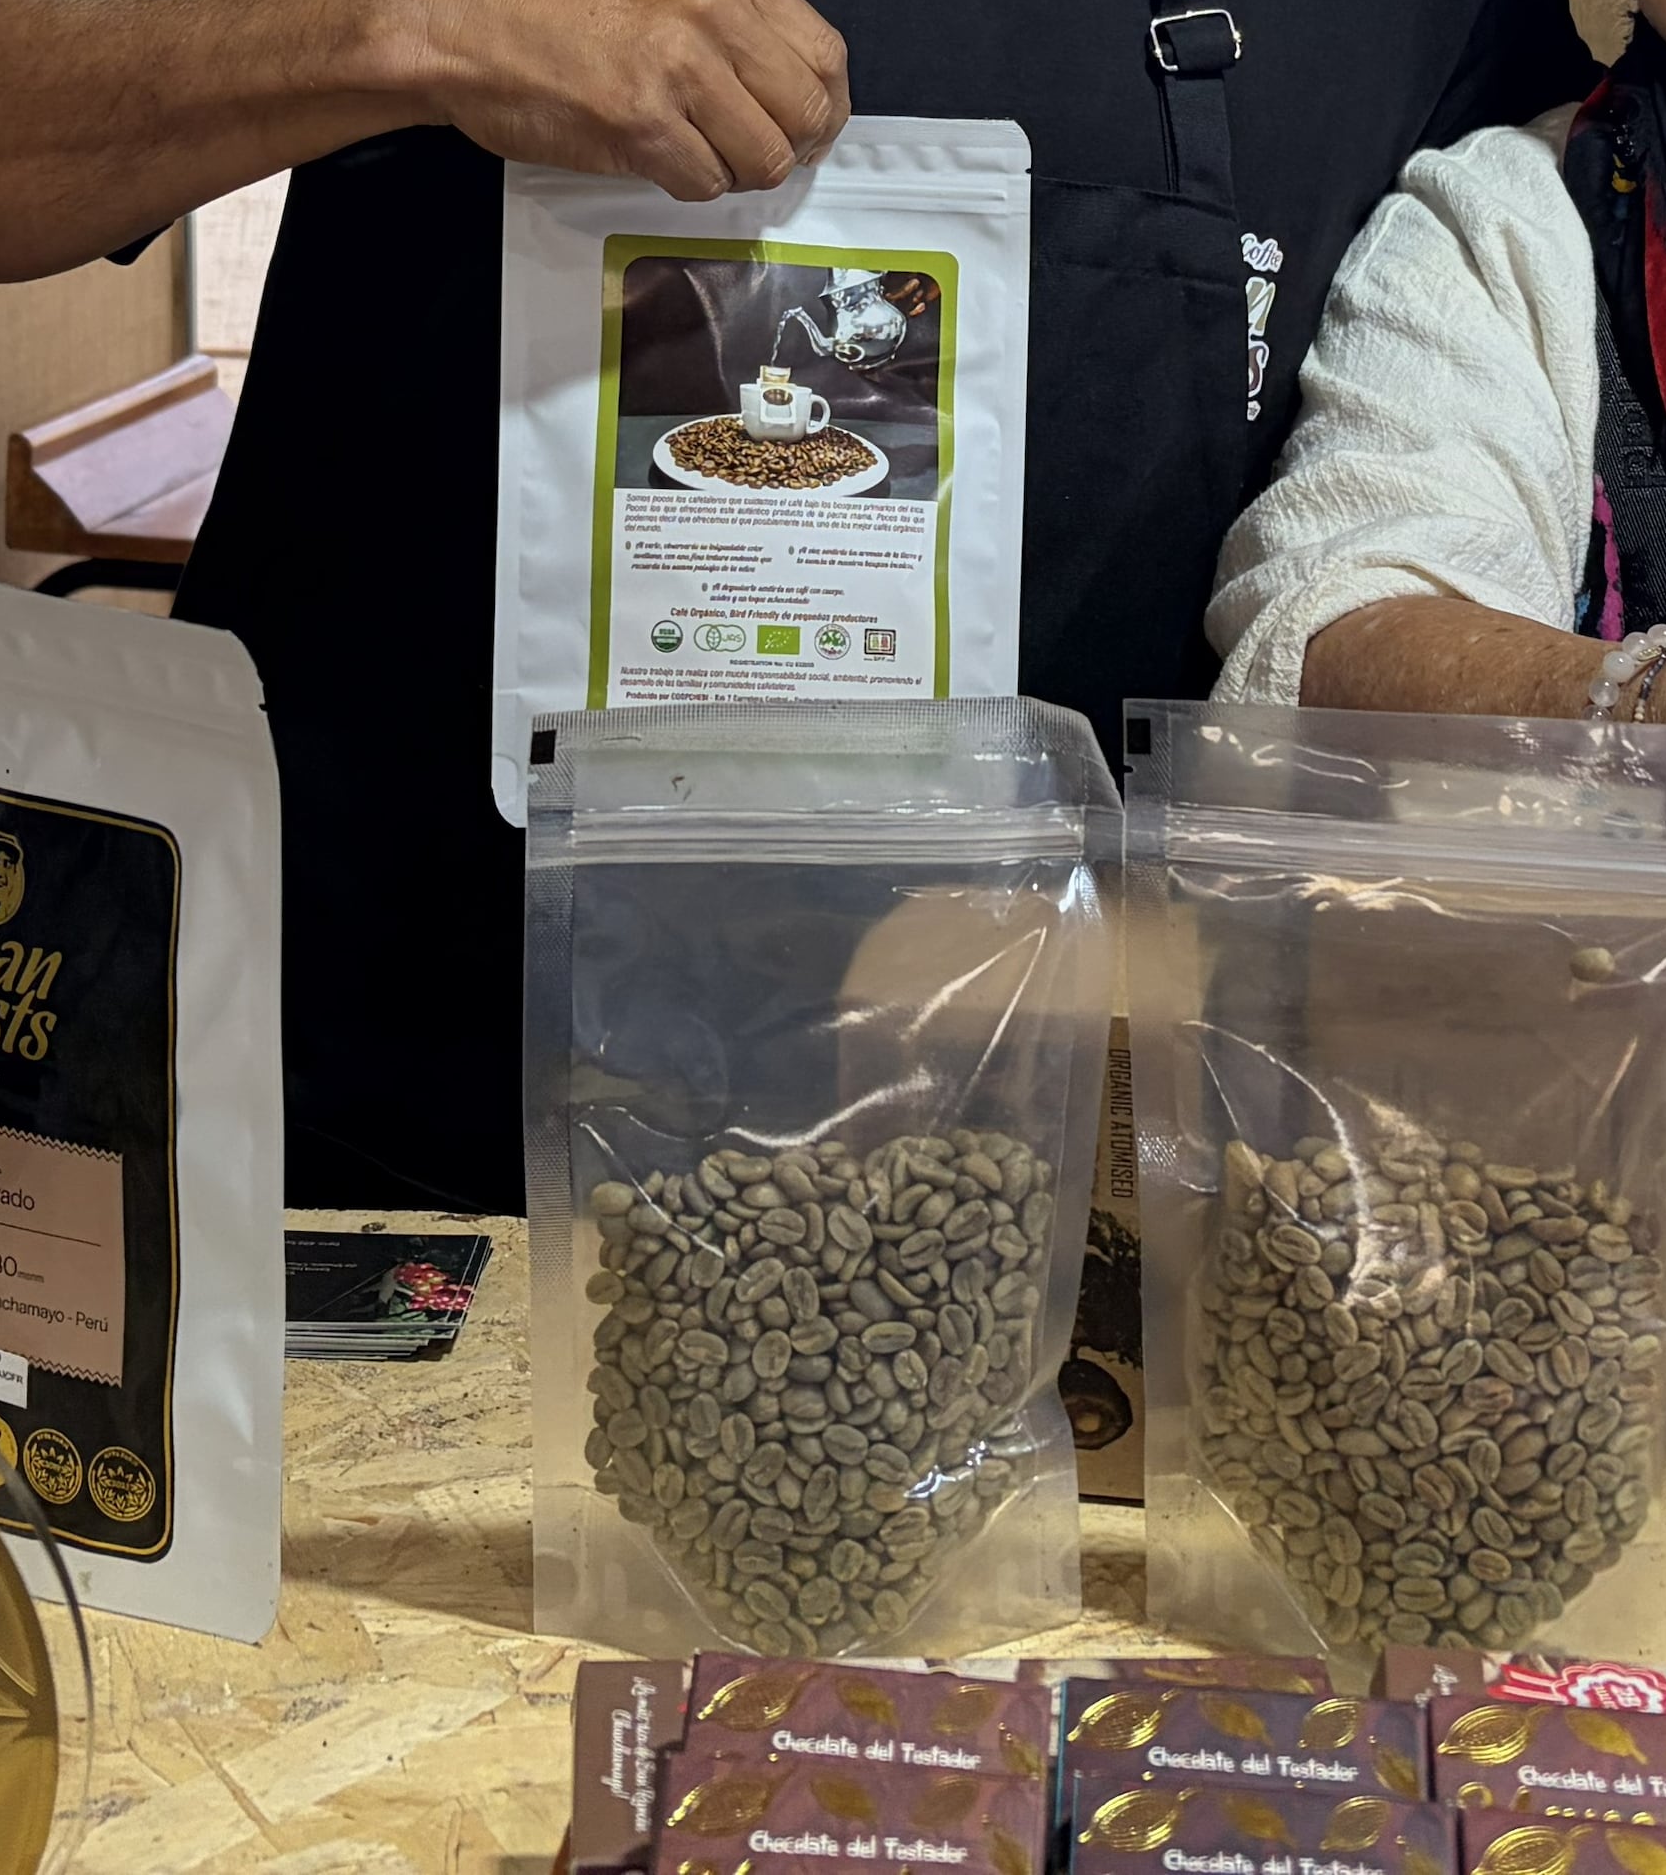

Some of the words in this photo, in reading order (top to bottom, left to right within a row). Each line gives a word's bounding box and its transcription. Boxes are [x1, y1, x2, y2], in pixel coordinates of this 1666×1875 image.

[1109, 1049, 1133, 1116] ORGANIC
[1110, 1120, 1134, 1198] ATOMISED
[75, 1310, 109, 1333] Perú
[864, 1739, 894, 1763] del
[1241, 1753, 1271, 1776] del
[1613, 1774, 1643, 1796] del
[845, 1835, 876, 1860] del
